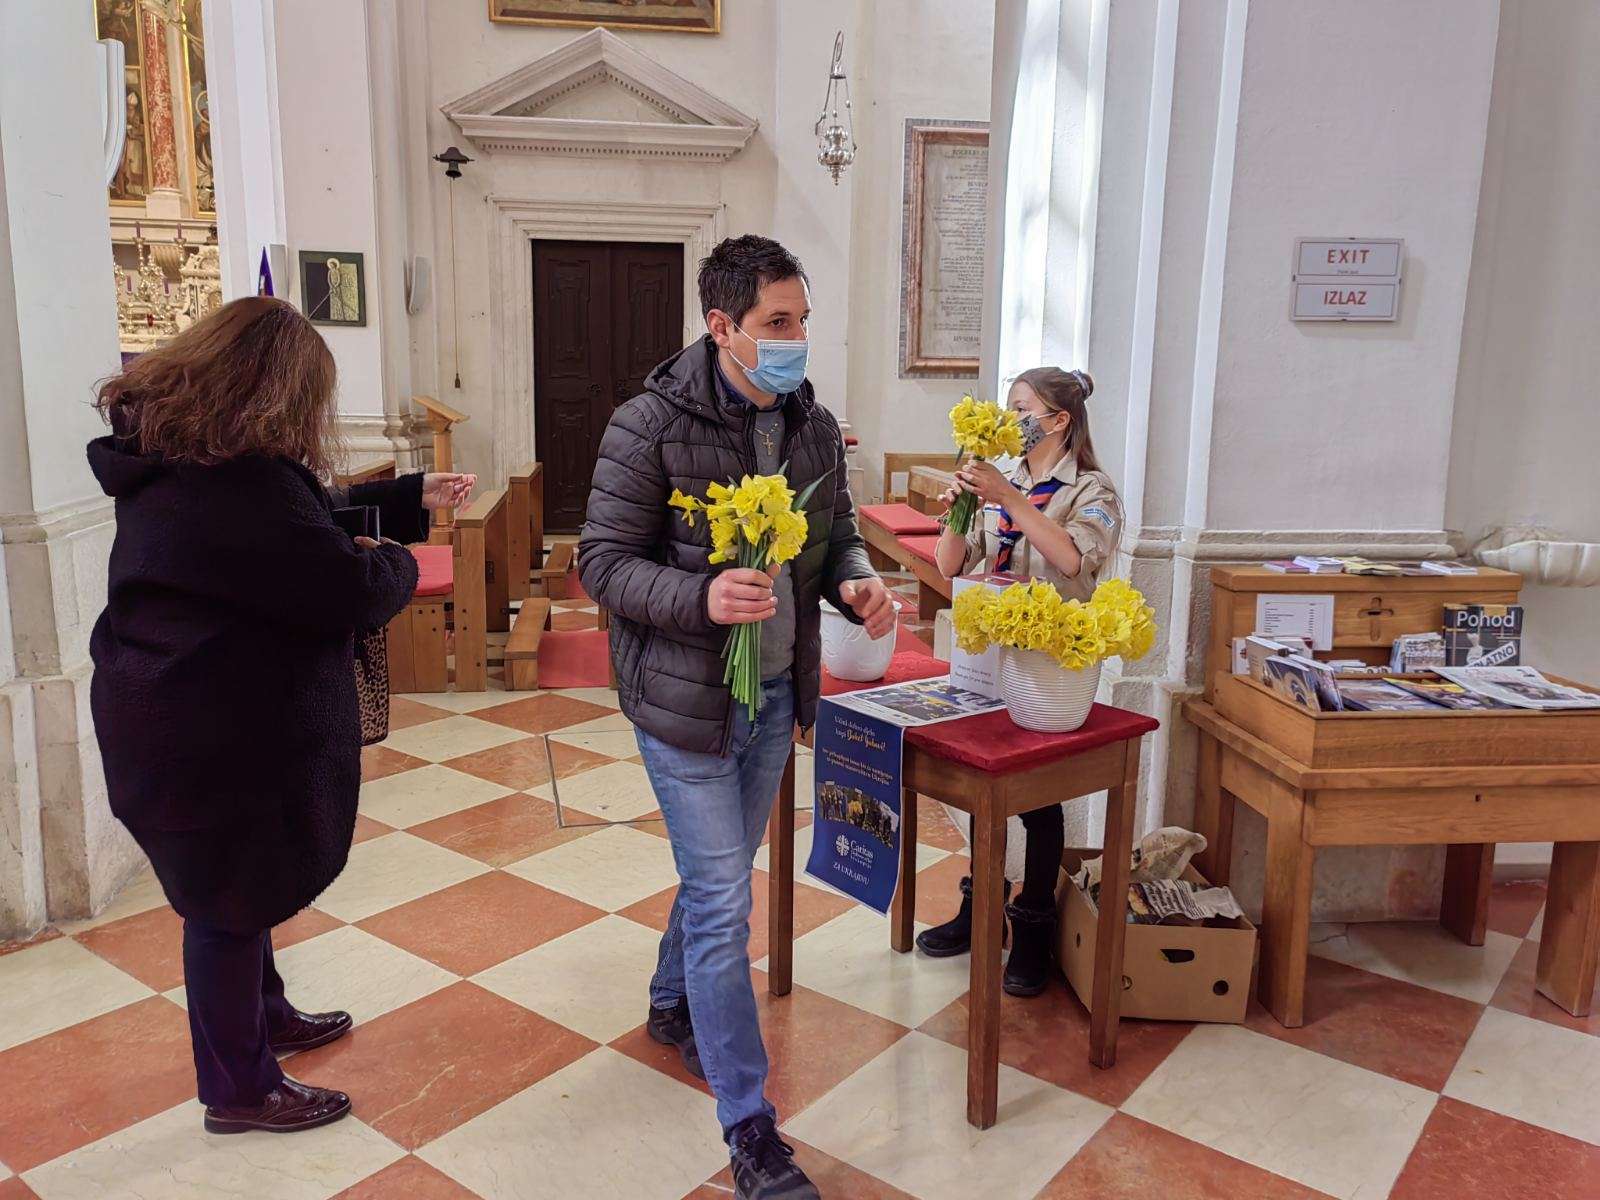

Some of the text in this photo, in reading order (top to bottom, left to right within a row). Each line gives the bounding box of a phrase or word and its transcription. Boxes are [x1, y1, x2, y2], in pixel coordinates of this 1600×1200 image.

[1327, 249, 1370, 264] EXIT
[1324, 291, 1368, 305] IZLAZ
[1456, 610, 1515, 628] Pohod
[850, 840, 874, 859] Caritas
